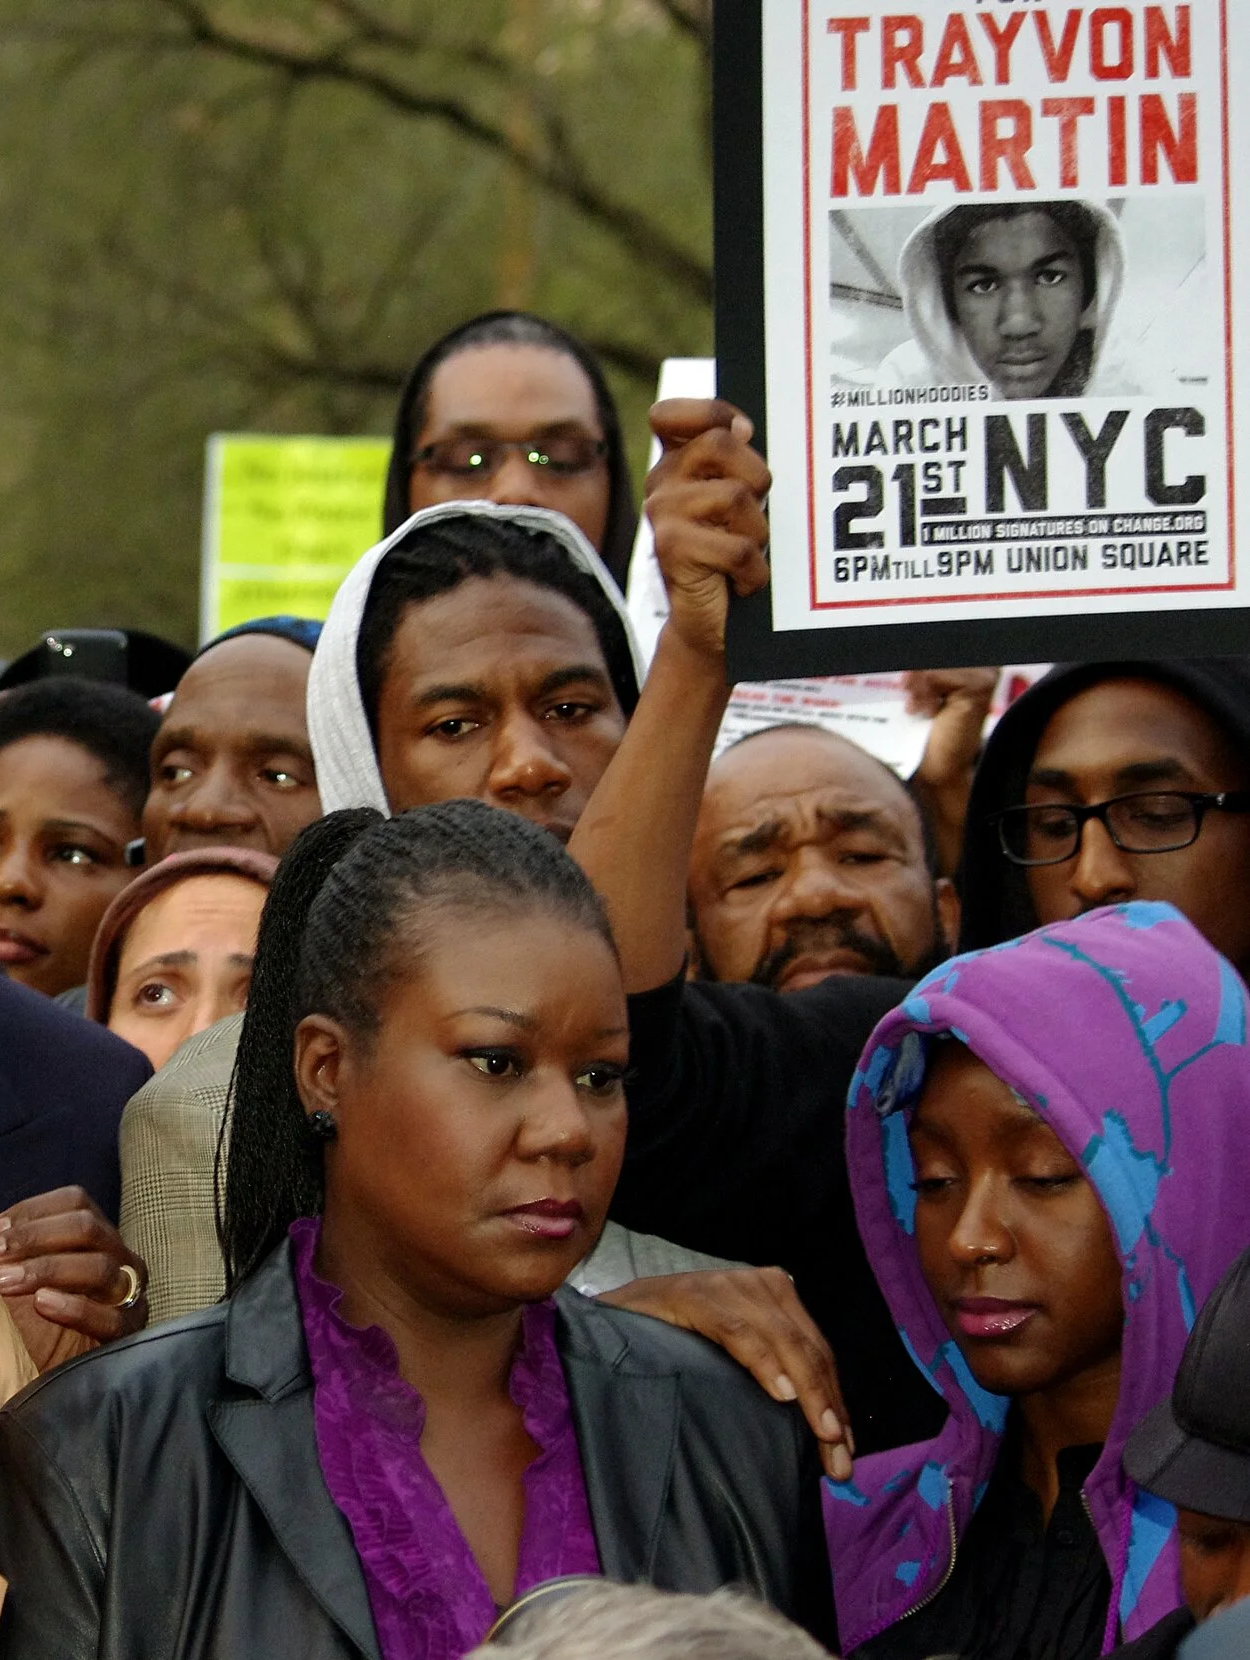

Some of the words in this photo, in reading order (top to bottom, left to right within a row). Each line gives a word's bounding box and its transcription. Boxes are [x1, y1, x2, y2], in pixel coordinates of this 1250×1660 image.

[826, 4, 1192, 91] TRAYVON
[829, 92, 1199, 198] MARTIN
[830, 384, 989, 409] #MILLIONHOODIES
[831, 416, 968, 458] MARCH
[984, 406, 1207, 514] NYC
[934, 524, 992, 541] MILLION
[996, 519, 1084, 538] SIGNATURES
[1089, 518, 1108, 534] ON
[1112, 515, 1204, 533] CHANGE.ORG
[1006, 545, 1089, 575] UNION
[1101, 540, 1210, 572] SQUARE
